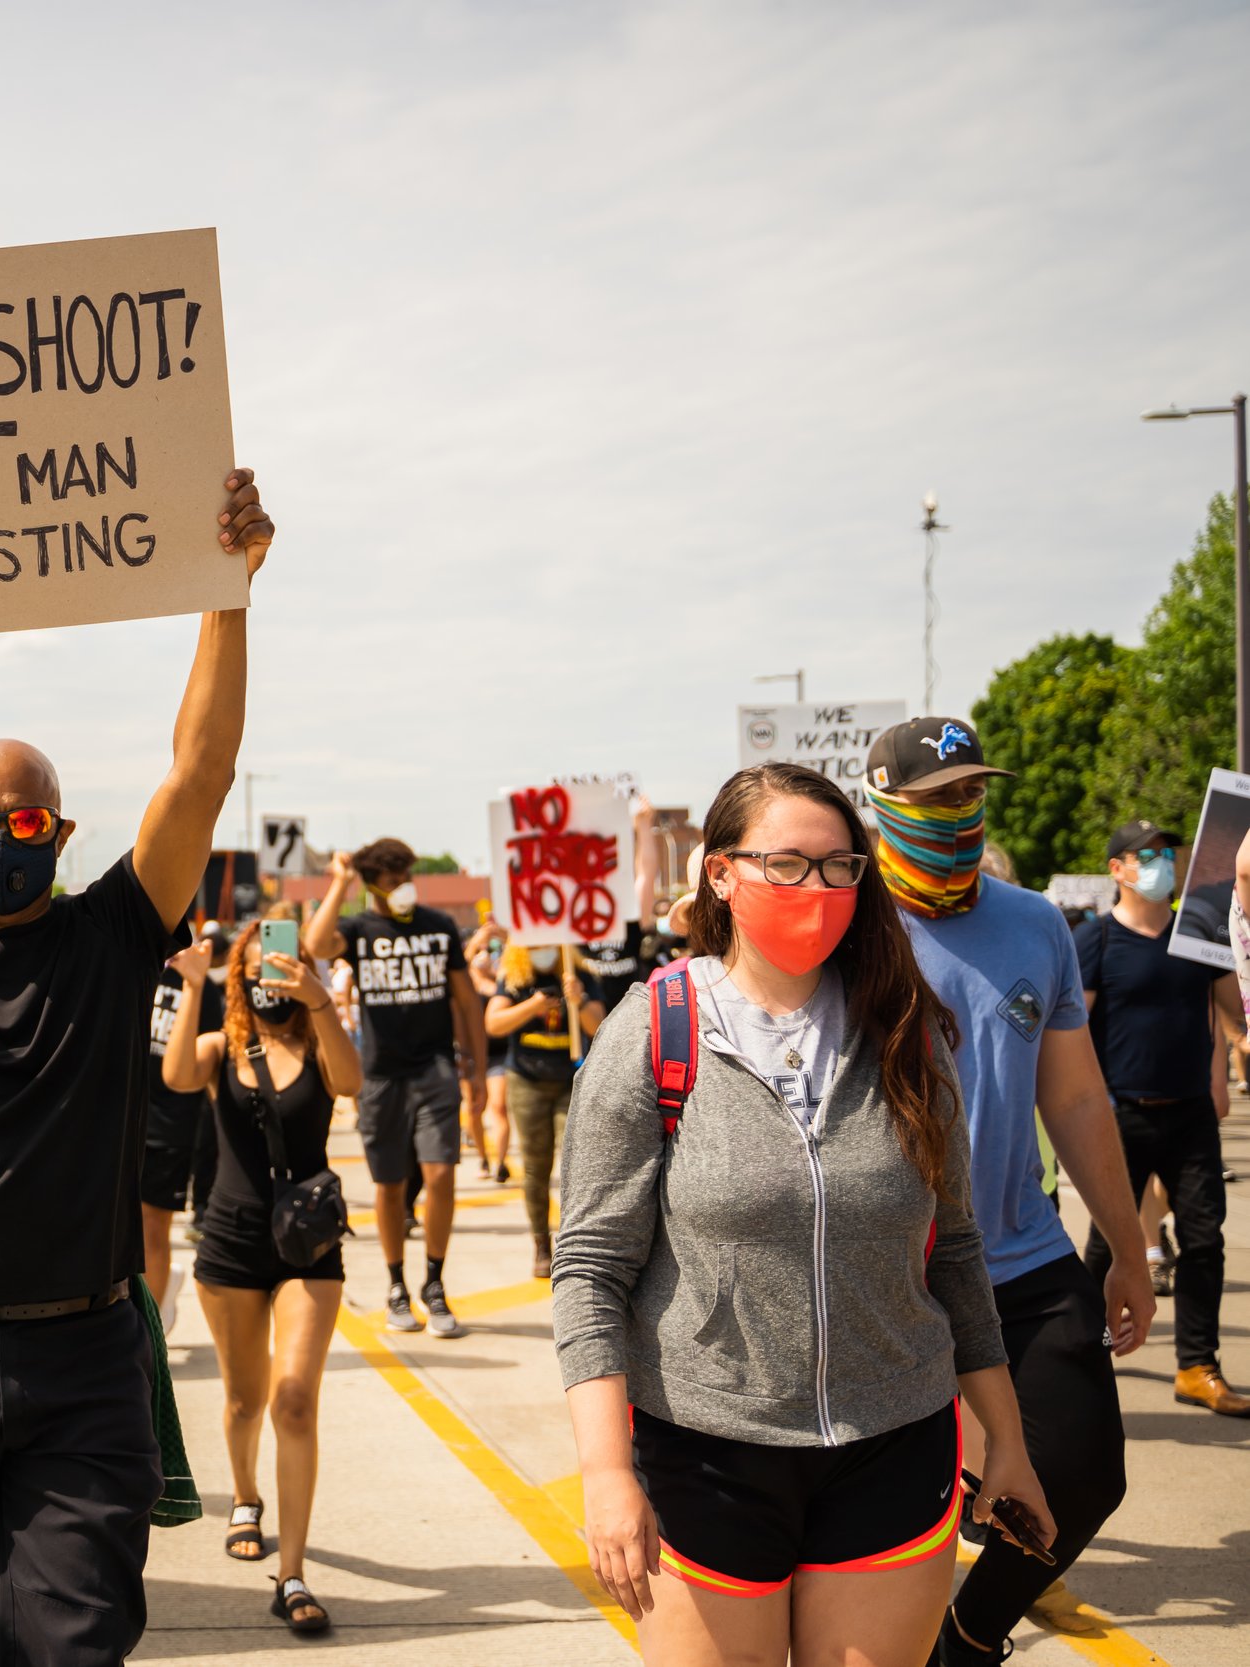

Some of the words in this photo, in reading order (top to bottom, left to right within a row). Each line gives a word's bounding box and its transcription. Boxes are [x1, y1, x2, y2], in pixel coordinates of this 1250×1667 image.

[17, 437, 137, 503] MAN
[814, 704, 859, 725] WE
[795, 727, 882, 750] WANT
[509, 786, 569, 834] NO
[509, 873, 565, 930] NO
[356, 937, 367, 958] I
[373, 932, 450, 959] CAN'T
[666, 978, 685, 1008] TRIBE
